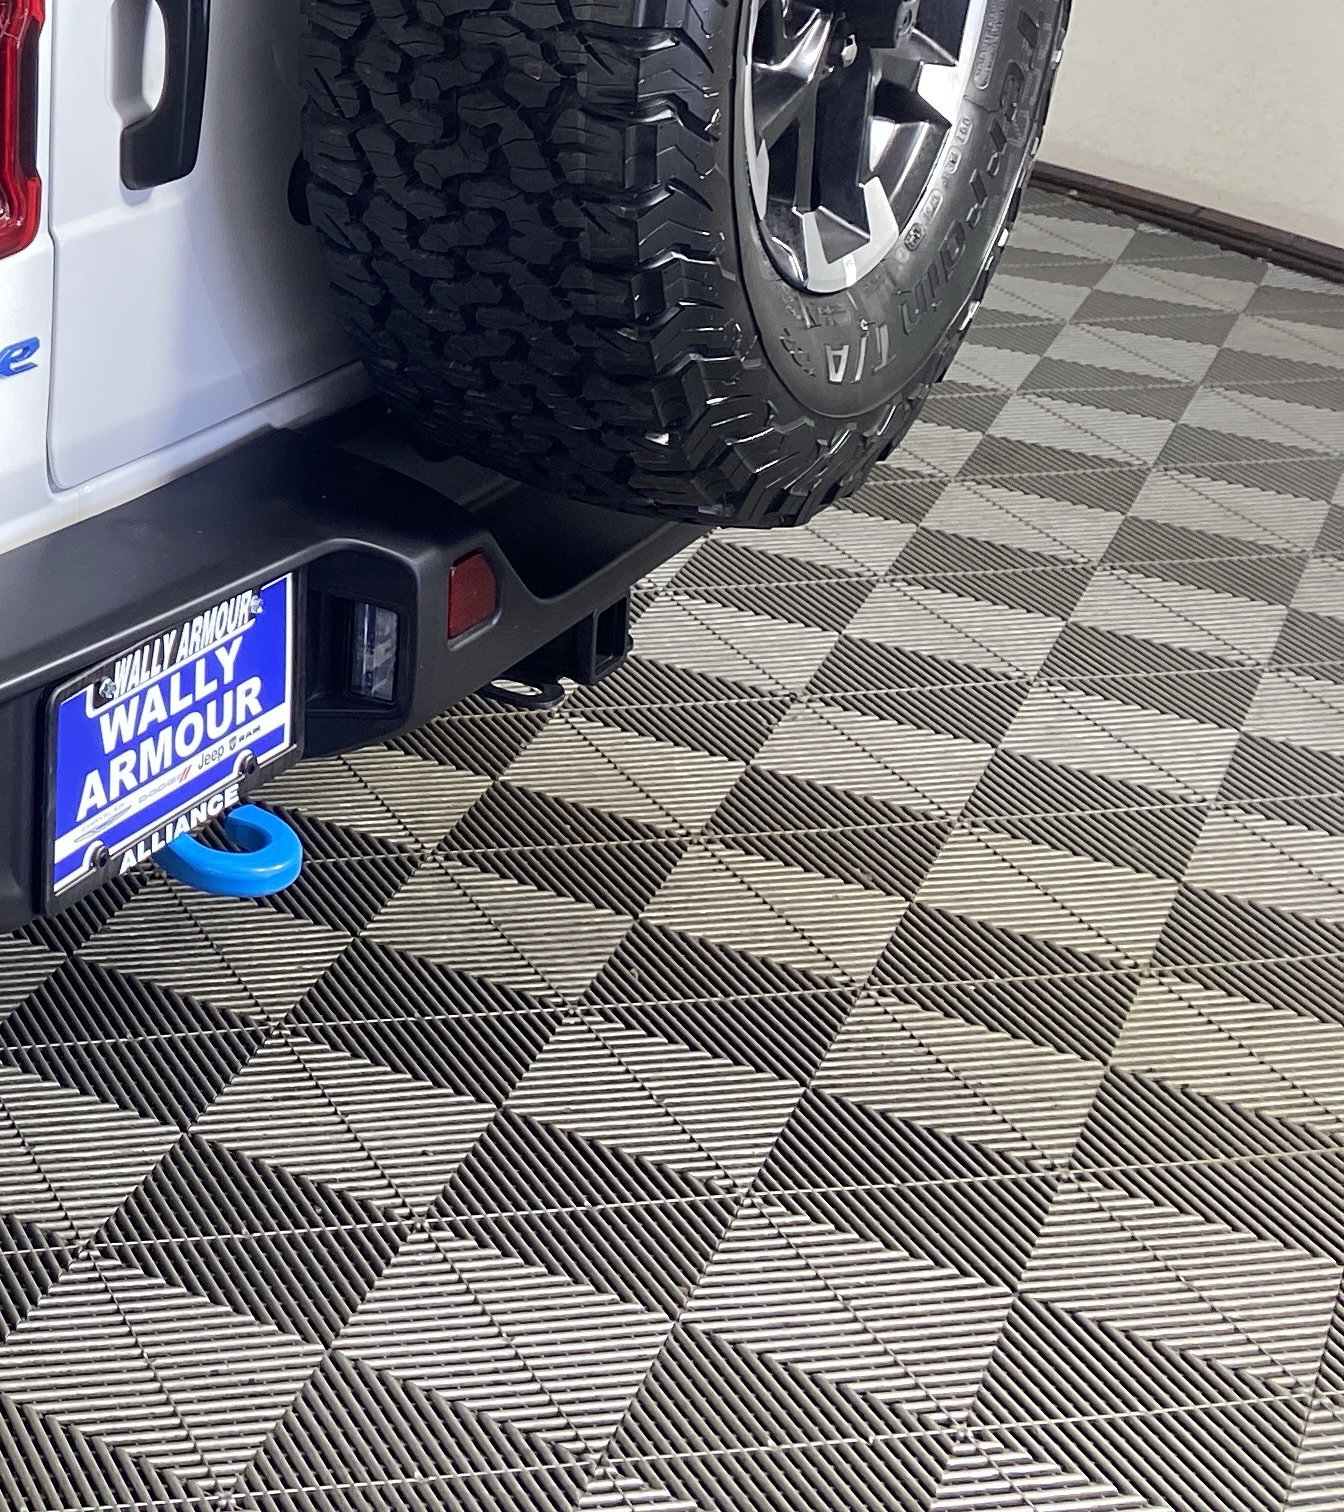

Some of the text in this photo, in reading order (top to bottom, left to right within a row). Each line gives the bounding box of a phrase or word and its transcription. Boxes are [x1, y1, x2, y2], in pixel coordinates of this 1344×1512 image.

[98, 635, 244, 755] WALLY
[113, 589, 254, 701] WALLY ARMOUR
[75, 676, 263, 823] ARMOUR
[197, 744, 225, 770] Jeep
[119, 784, 241, 875] ALLIANCE
